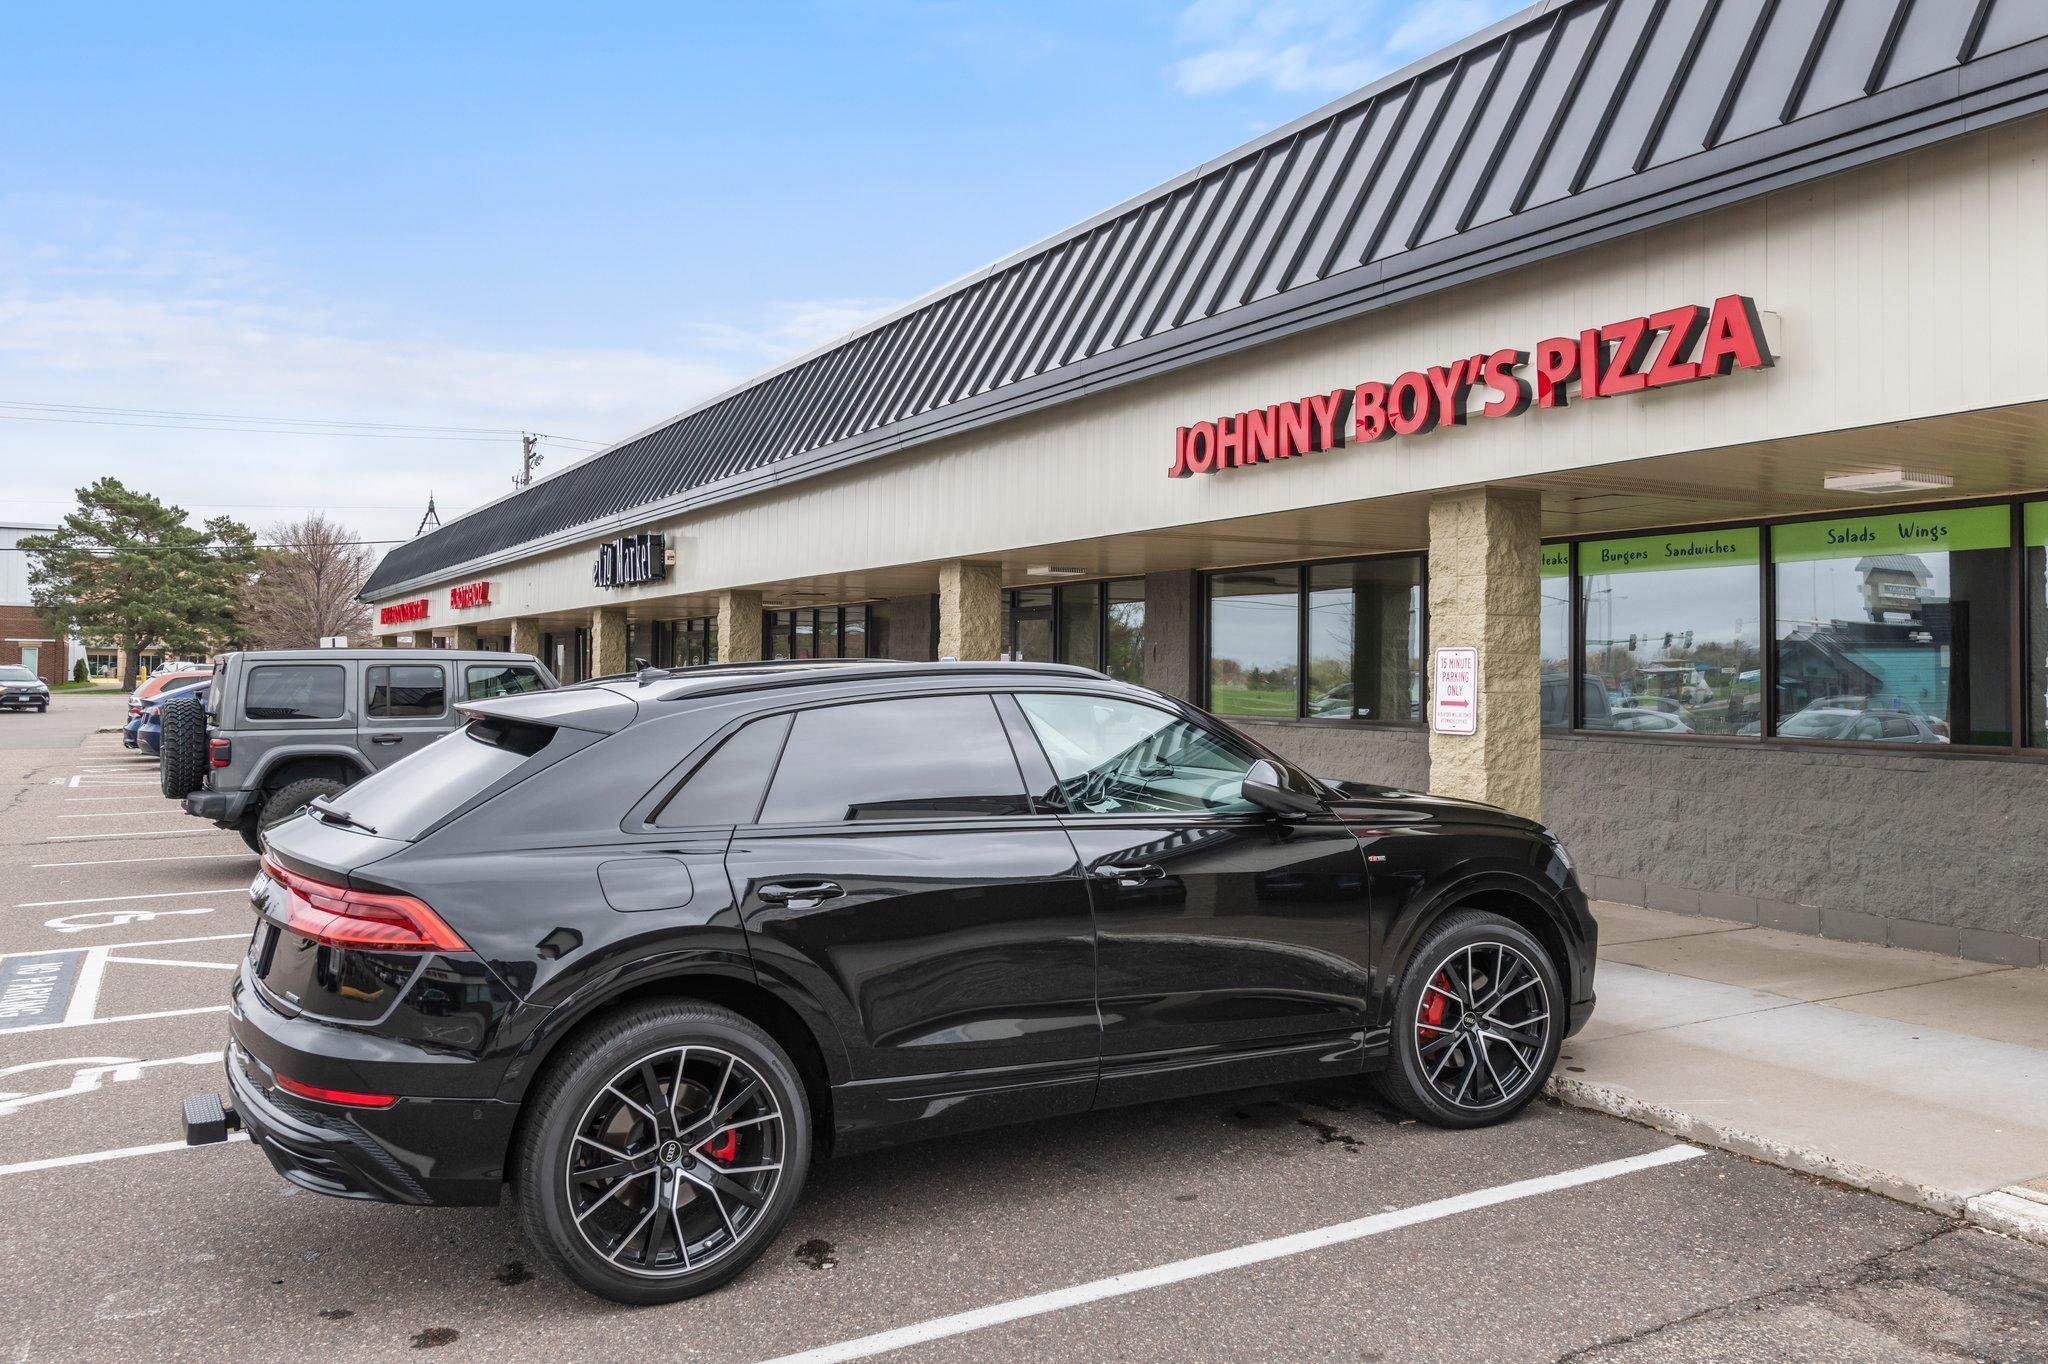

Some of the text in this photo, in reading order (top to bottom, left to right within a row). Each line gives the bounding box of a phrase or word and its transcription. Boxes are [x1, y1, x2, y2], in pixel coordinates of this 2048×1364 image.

[1168, 293, 1774, 478] JOHNNY BOY'S PIZZA
[616, 531, 652, 583] Market
[1541, 522, 1948, 566] teaks Burgers Sandwiches Salads Wings
[1441, 658, 1471, 669] 15 MINUTE
[1442, 671, 1469, 683] PARKING
[1447, 685, 1463, 696] ONLY
[0, 976, 58, 1017] PARKING
